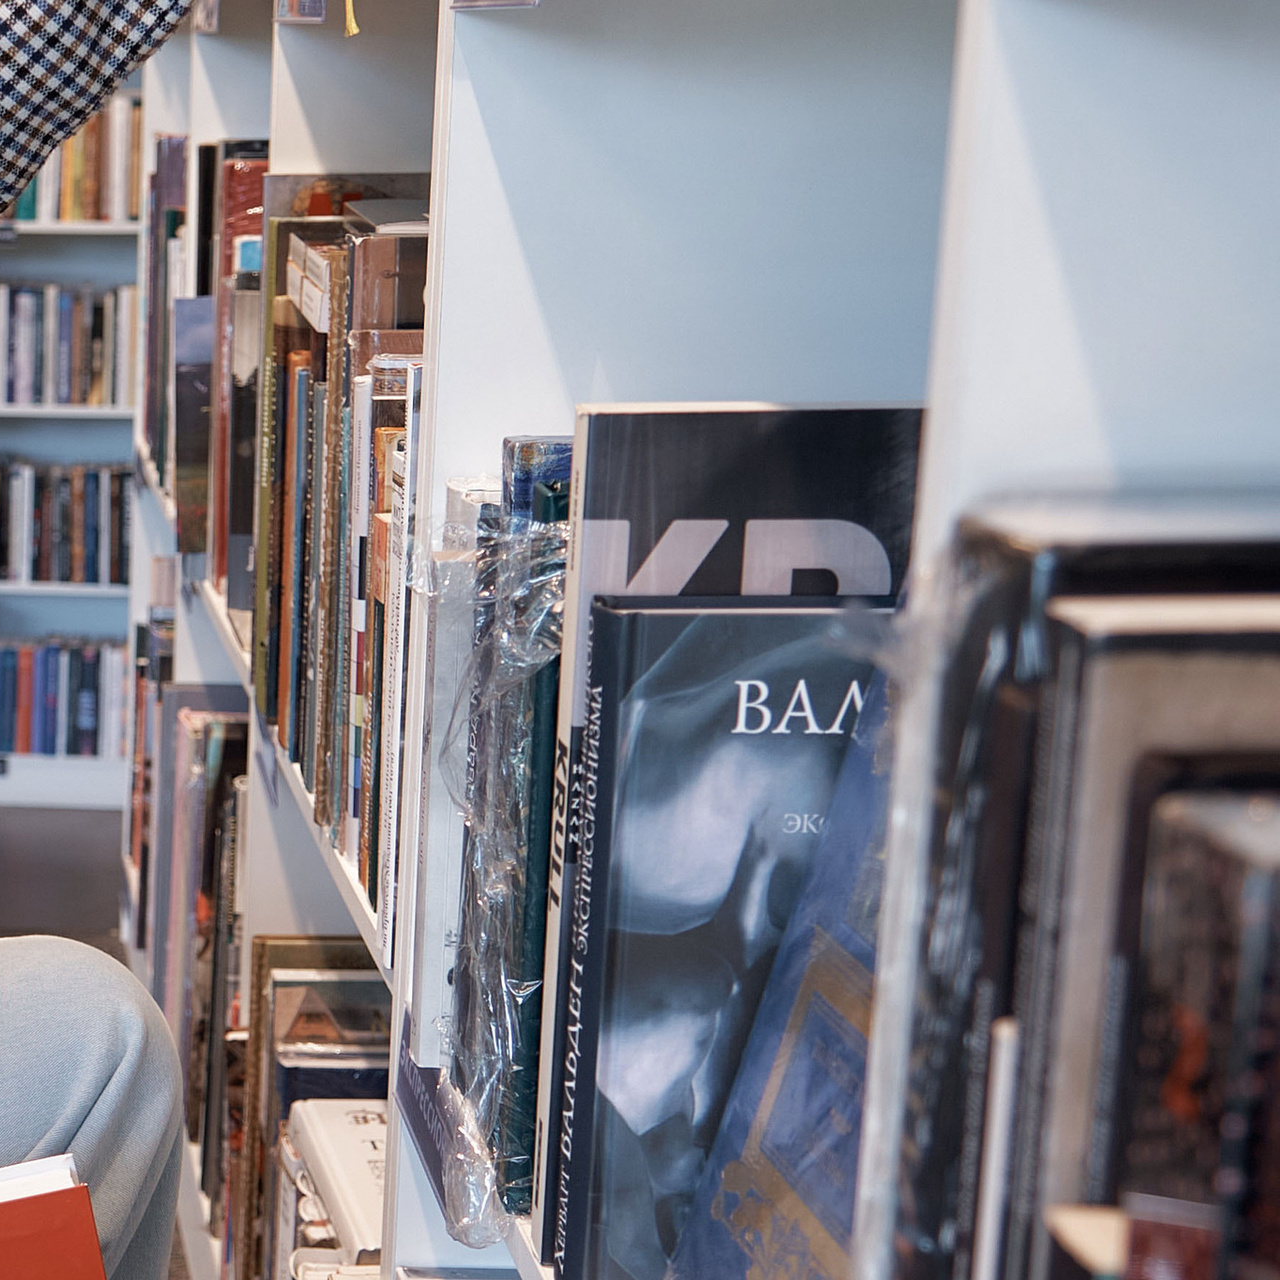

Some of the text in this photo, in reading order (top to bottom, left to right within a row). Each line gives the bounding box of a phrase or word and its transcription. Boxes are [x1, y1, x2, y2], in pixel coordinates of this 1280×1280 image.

[547, 738, 569, 913] KRULL
[577, 685, 603, 954] ЭКСПРЕССИОНИЗМА
[560, 965, 585, 1162] ВАЛЬДЕН
